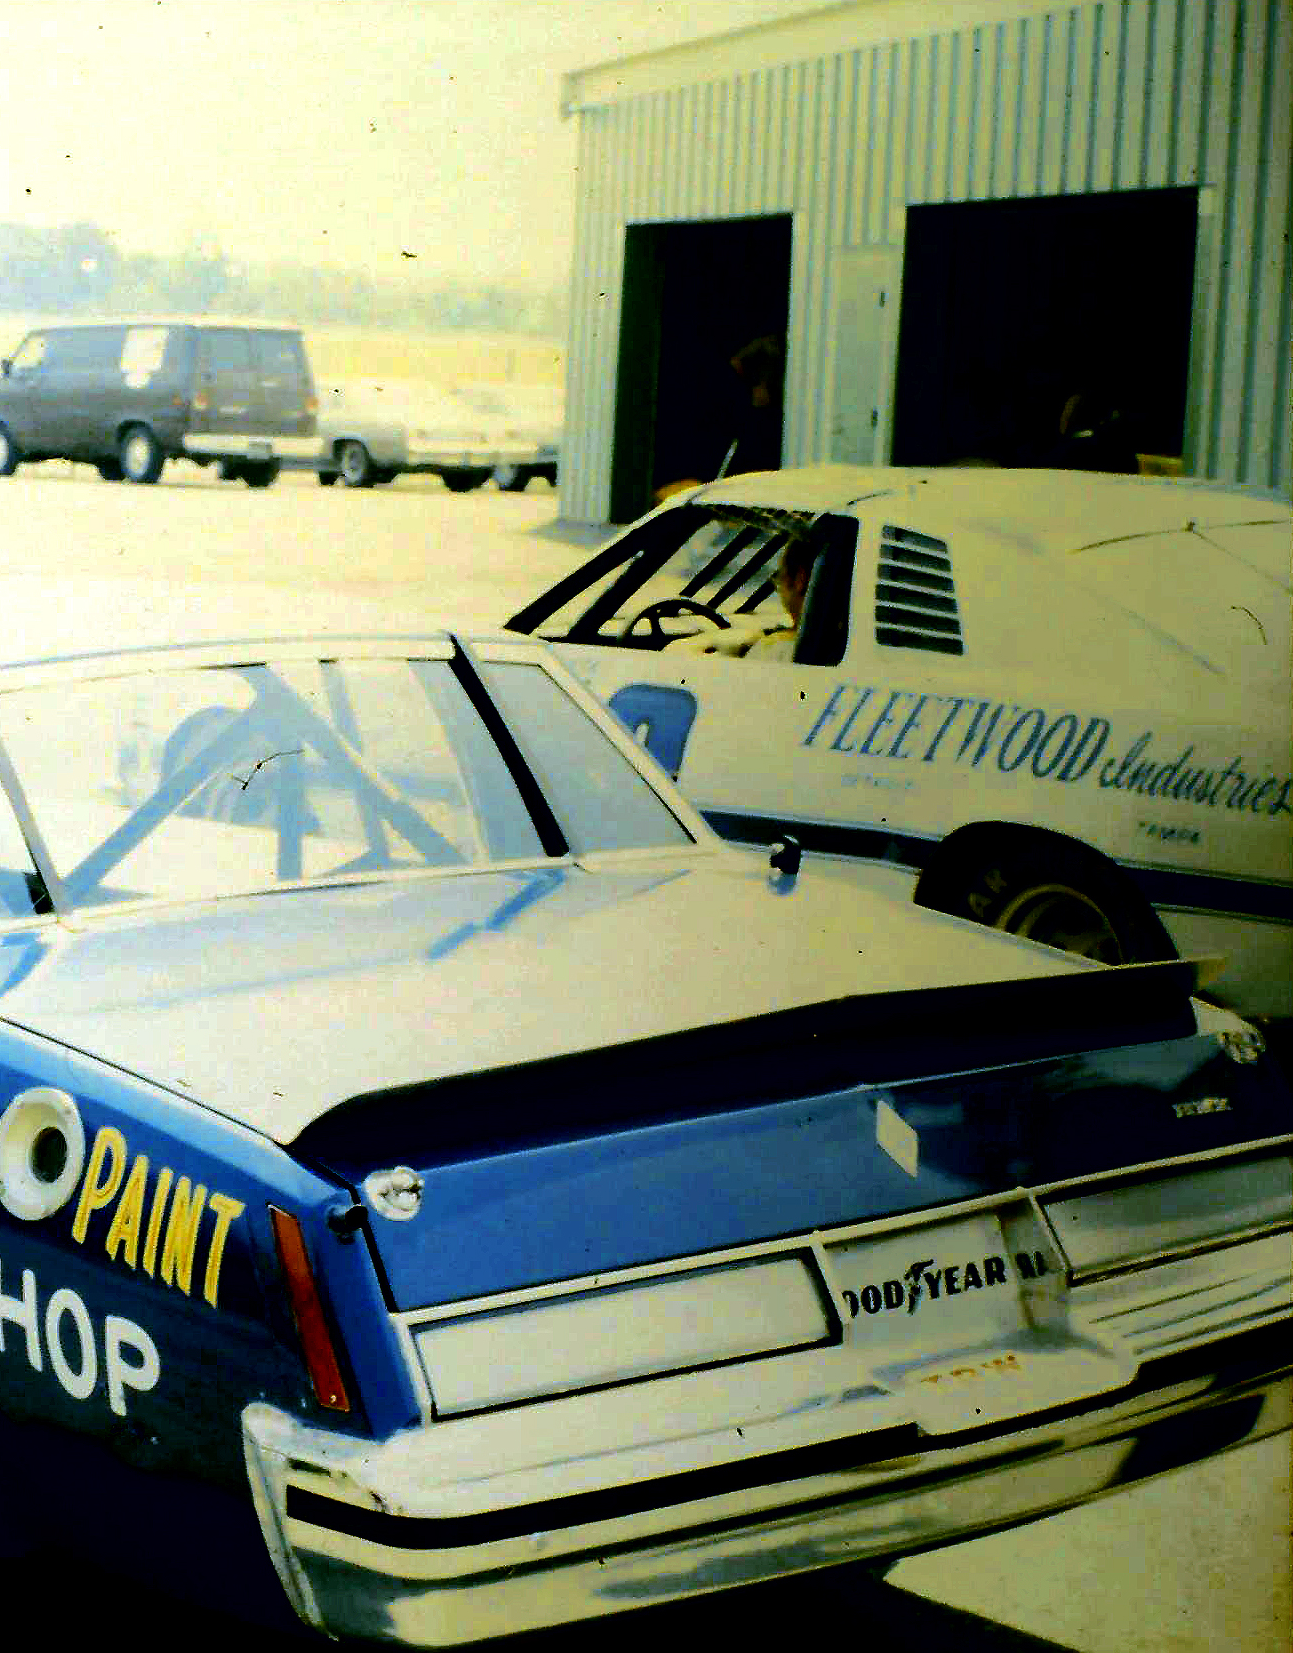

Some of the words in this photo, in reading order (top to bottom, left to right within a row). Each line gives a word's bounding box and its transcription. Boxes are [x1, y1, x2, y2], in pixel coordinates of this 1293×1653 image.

[801, 683, 1111, 782] FLEETWOOD
[1098, 730, 1293, 815] Industries
[71, 1125, 247, 1310] PAINT
[841, 1254, 1006, 1318] OODYEAR
